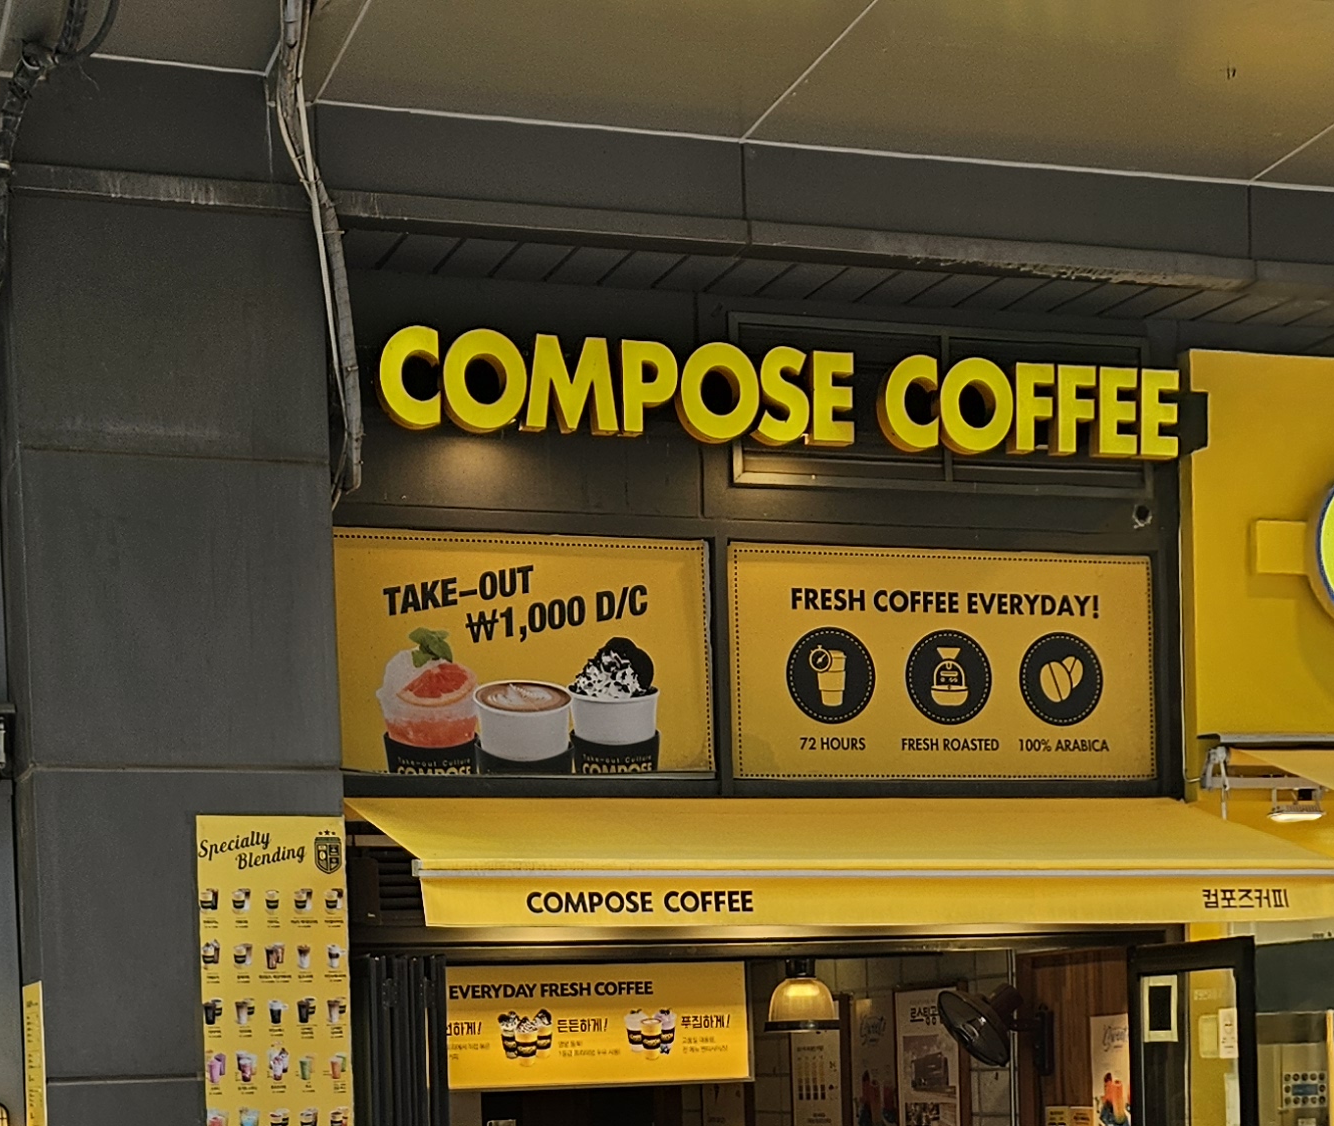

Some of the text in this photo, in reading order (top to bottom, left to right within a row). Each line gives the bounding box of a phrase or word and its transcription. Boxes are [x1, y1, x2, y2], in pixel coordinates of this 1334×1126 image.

[379, 325, 1182, 460] COMPOSE COFFEE
[383, 565, 534, 616] TAKE-OUT
[466, 585, 648, 643] ₩1,000 D/C
[791, 588, 1100, 619] FRESH COFFEE EVERYDAY!
[799, 737, 866, 751] 72 HOURS
[901, 738, 1000, 752] FRESH ROASTED
[1018, 739, 1109, 752] 100% ARABICA
[198, 831, 270, 860] Specialty
[235, 844, 306, 870] Blending
[527, 891, 753, 913] COMPOSE COFFEE
[1202, 889, 1289, 908] 컴포즈커피
[449, 981, 653, 999] EVERYDAY FRESH COFFEE
[557, 1018, 608, 1034] 든든하게!
[680, 1014, 731, 1029] 푸짐하게!
[910, 1006, 940, 1026] 로스팅공
